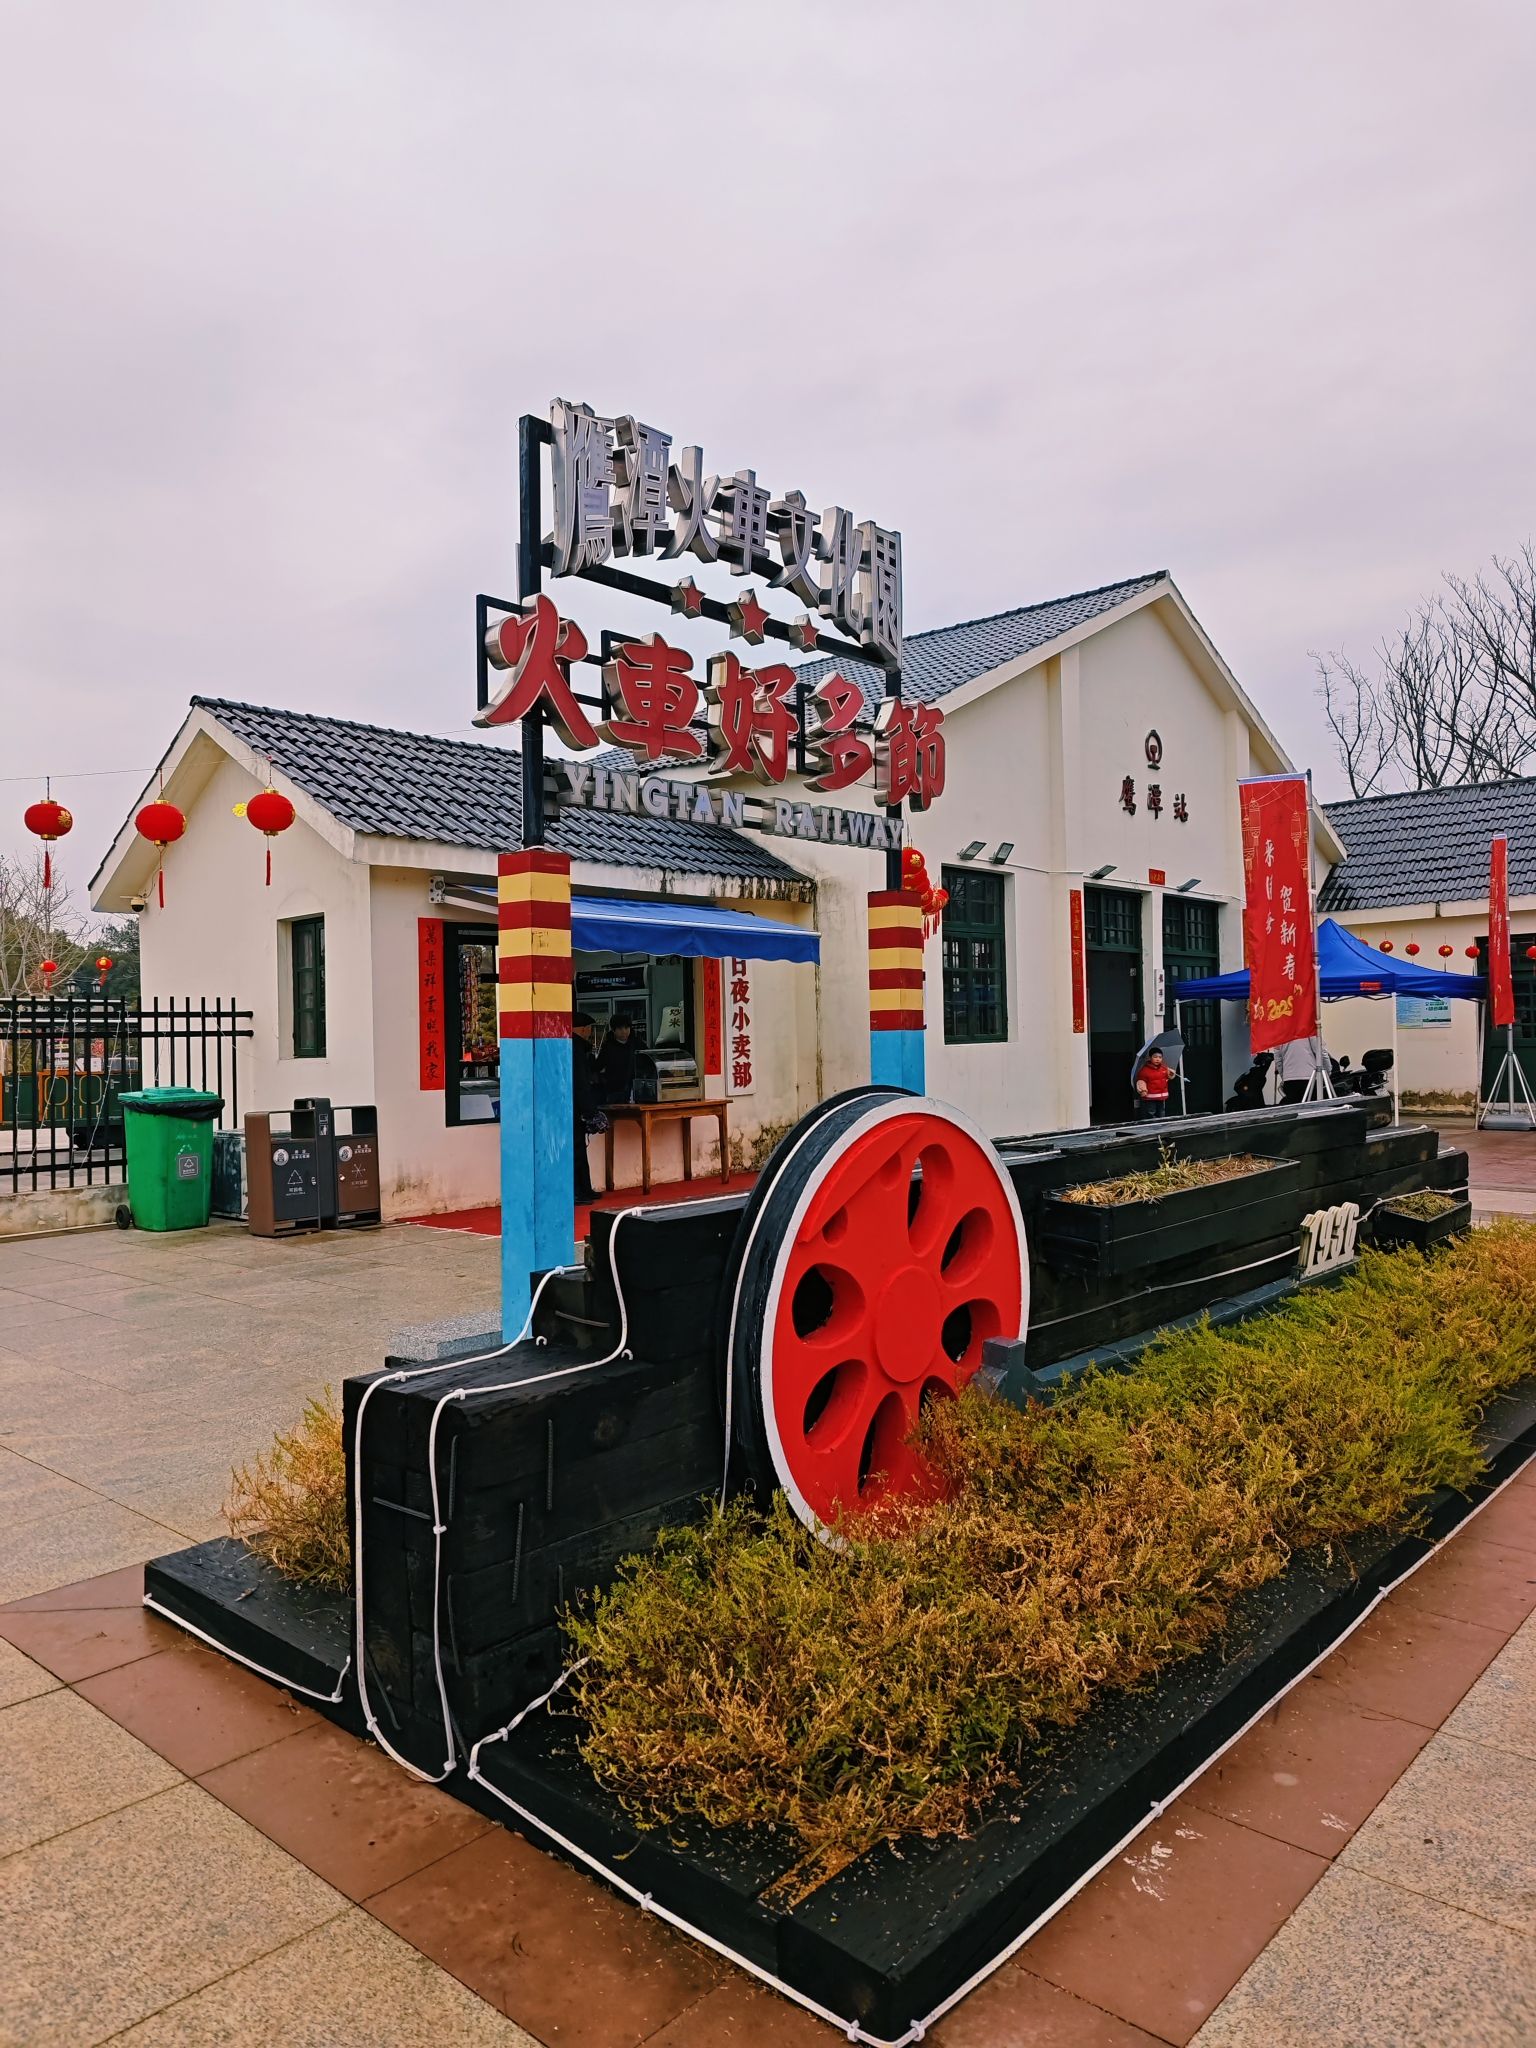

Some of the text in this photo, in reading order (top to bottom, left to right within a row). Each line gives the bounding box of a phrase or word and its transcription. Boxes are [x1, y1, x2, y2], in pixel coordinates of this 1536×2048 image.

[472, 593, 946, 812] 火車好多節
[560, 761, 904, 850] YINGTAN RAILWAY
[1118, 774, 1189, 823] 鹰潭站
[1280, 884, 1297, 981] 贺新春
[1267, 995, 1294, 1022] 2025
[1299, 1201, 1360, 1276] 1936
